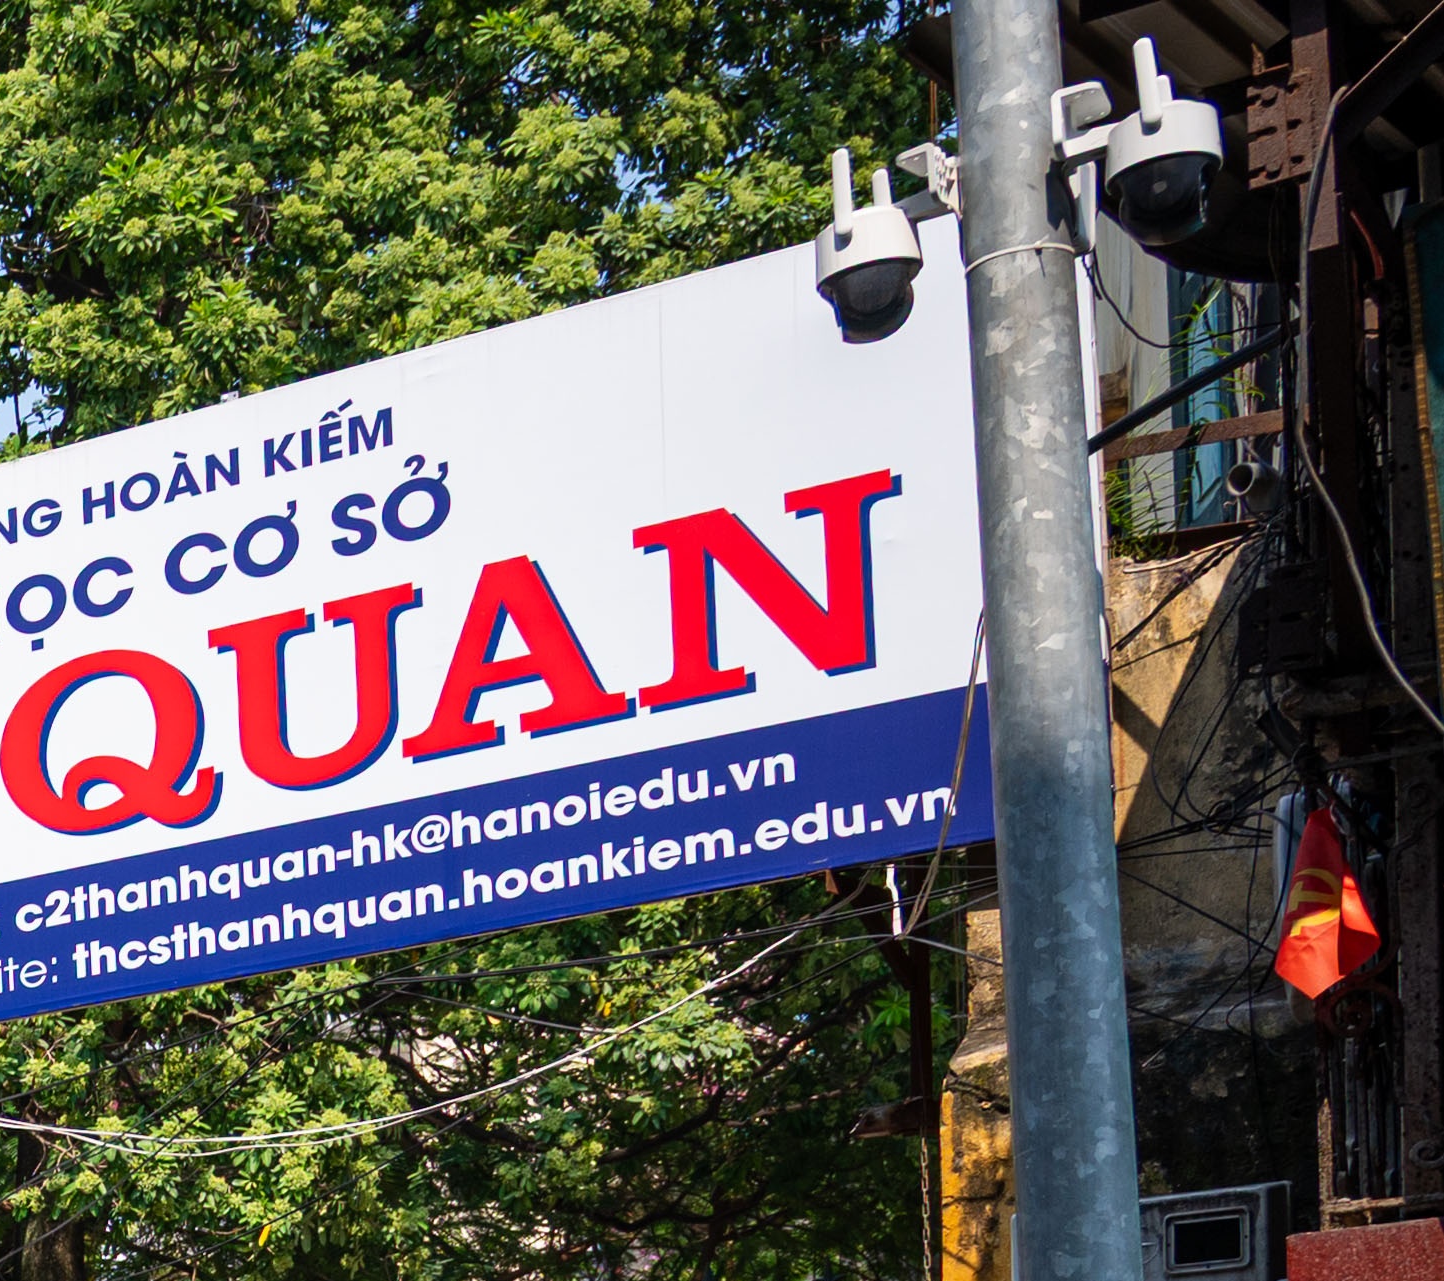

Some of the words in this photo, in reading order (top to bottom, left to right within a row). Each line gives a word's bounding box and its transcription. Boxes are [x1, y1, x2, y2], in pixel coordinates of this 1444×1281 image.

[82, 449, 239, 523] HOÀN
[263, 401, 395, 476] KIẾM
[166, 510, 297, 596] CƠ
[332, 456, 452, 556] SỞ
[0, 469, 901, 835] QUAN
[14, 746, 796, 933] c2thanhquan-hk@hanoiedu.vn
[72, 779, 958, 980] thcsthanhquan.hoankiem.edu.vn
